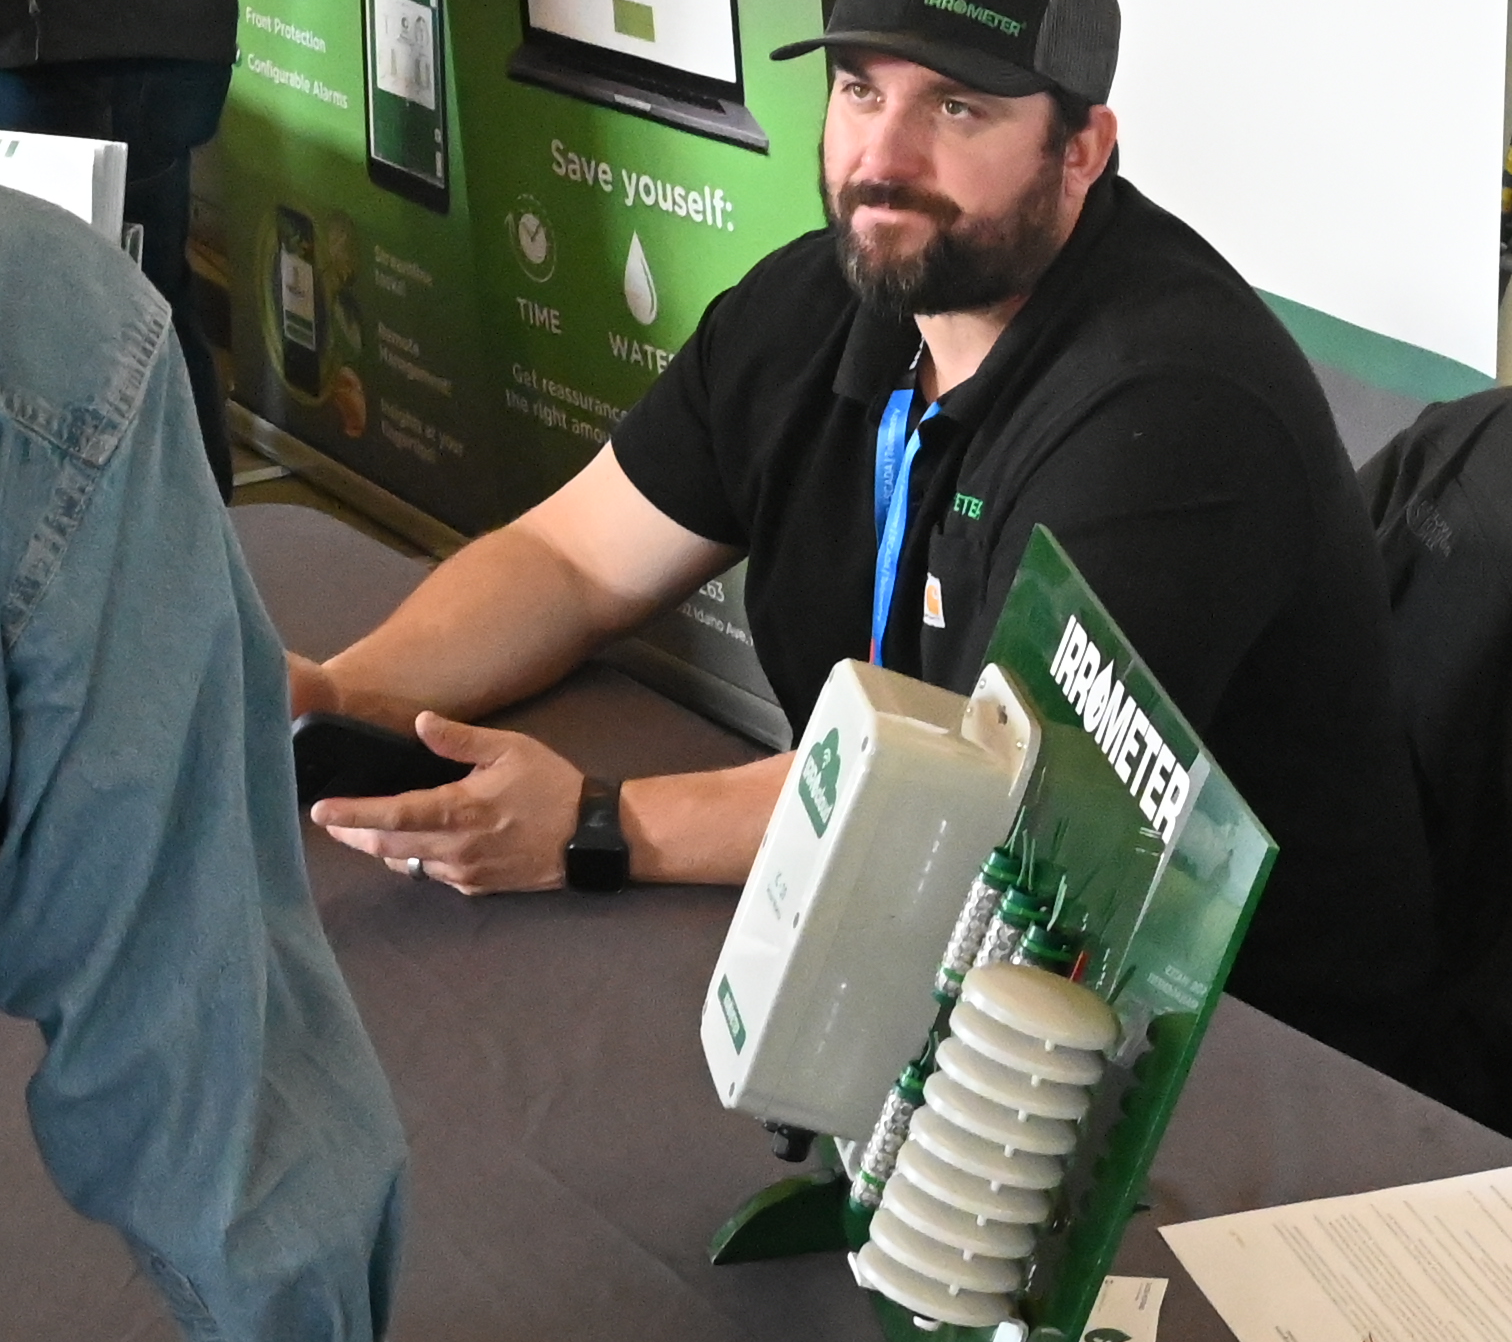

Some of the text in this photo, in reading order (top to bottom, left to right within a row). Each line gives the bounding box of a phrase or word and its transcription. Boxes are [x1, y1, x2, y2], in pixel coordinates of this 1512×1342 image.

[275, 17, 327, 53] Protection
[248, 53, 348, 109] Configurable Alarms
[551, 139, 735, 233] Save youself:
[516, 296, 562, 334] TIME
[512, 363, 539, 390] Get
[505, 388, 528, 413] the
[533, 401, 568, 431] right
[1050, 614, 1190, 845] IRROMETER
